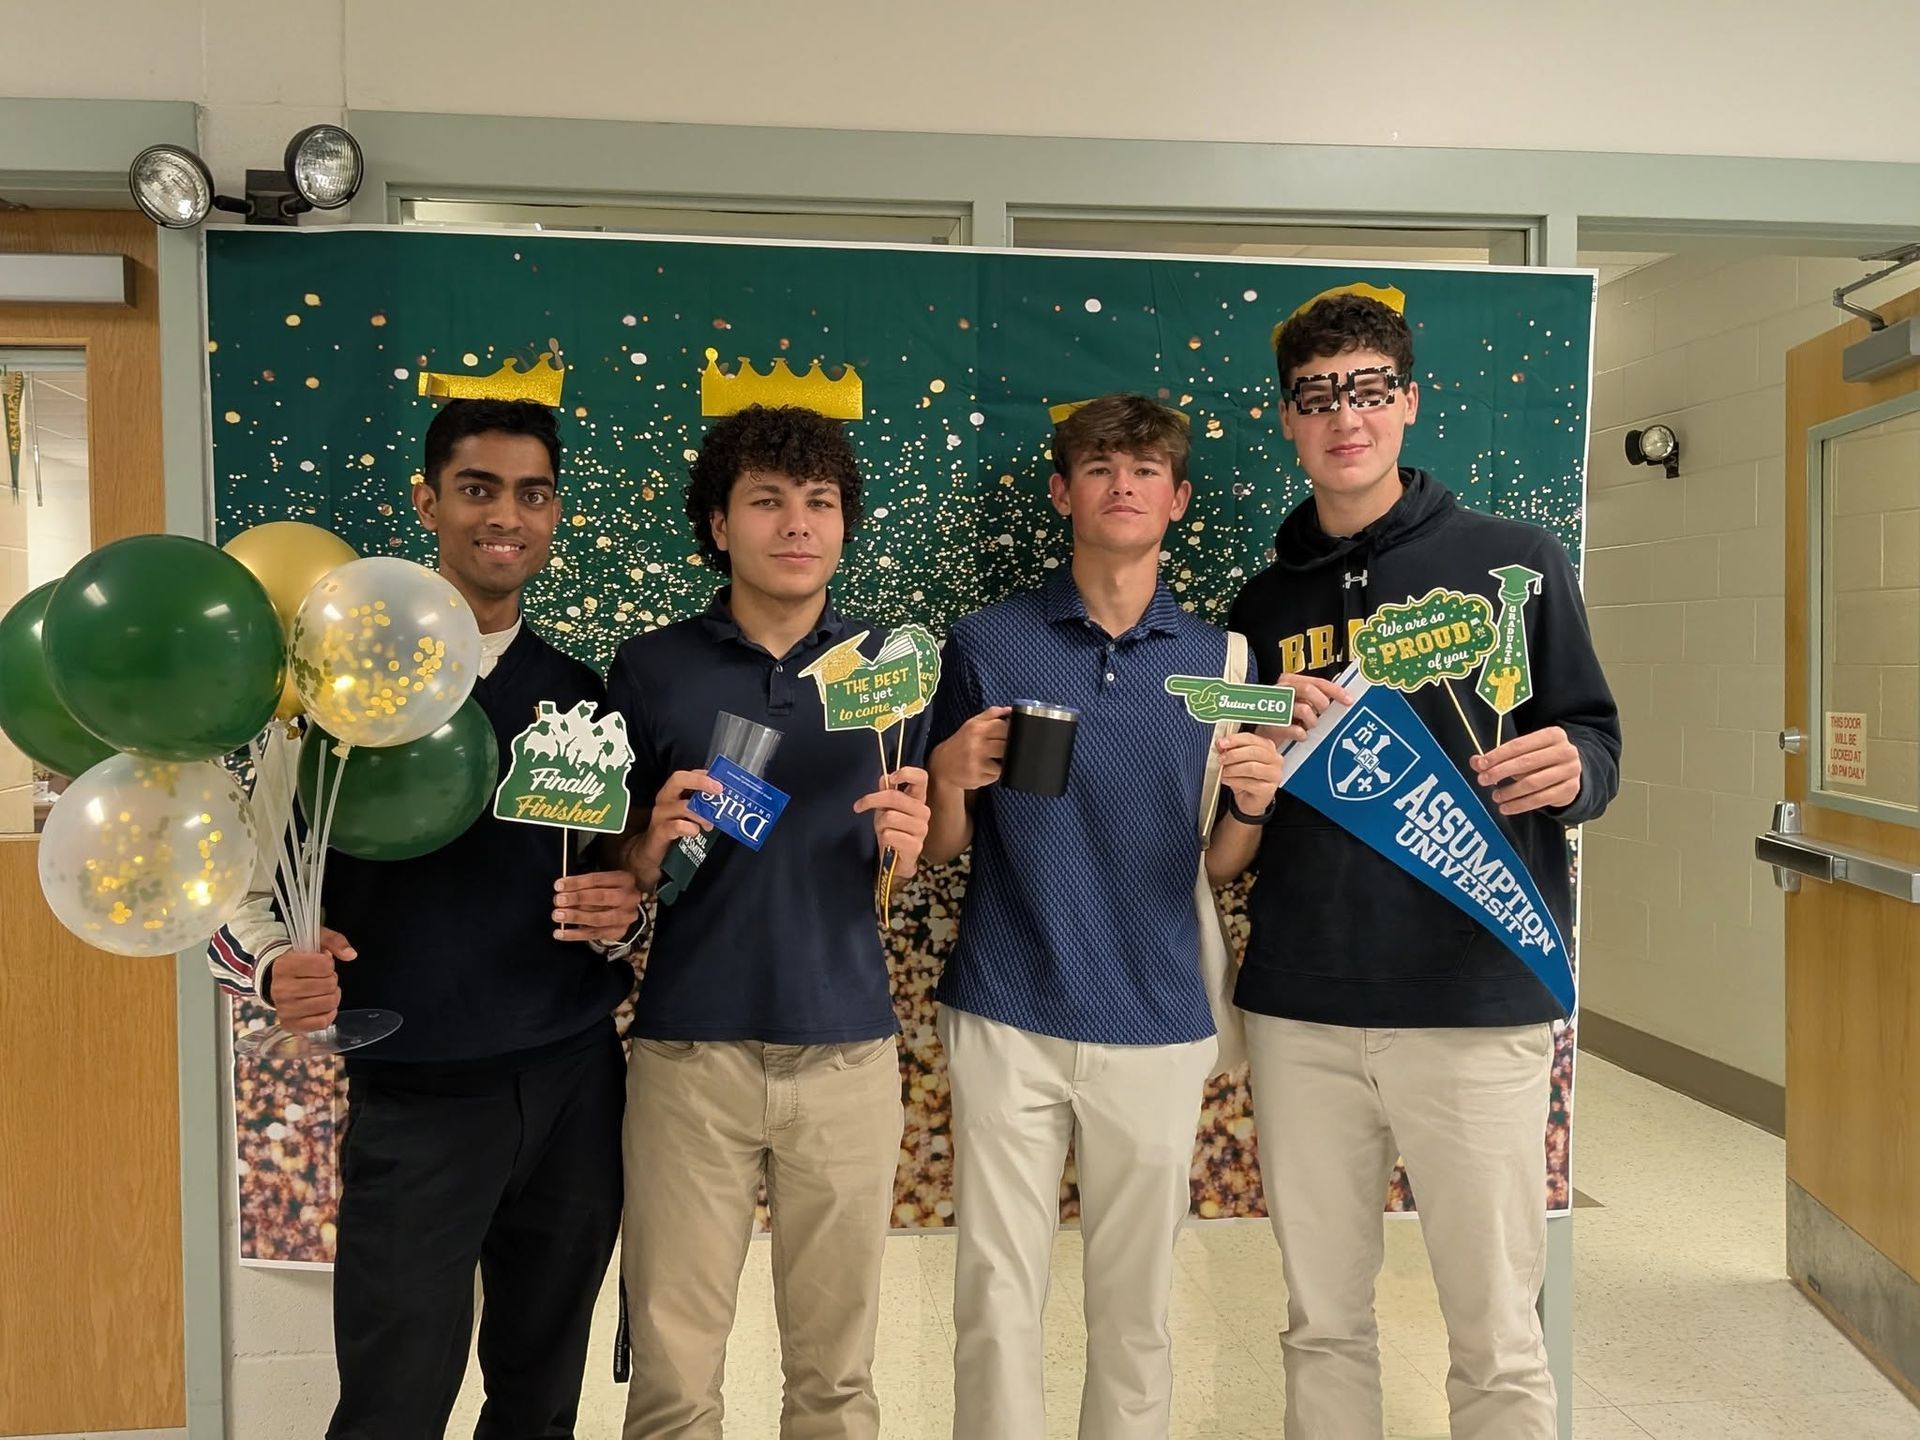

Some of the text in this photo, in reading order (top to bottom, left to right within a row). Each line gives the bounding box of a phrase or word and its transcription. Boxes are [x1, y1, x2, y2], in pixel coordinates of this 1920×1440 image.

[1377, 612, 1445, 637] We are so
[1503, 605, 1516, 665] GRADUATE
[1379, 621, 1471, 665] PROUD
[1427, 650, 1469, 670] of you
[843, 677, 870, 695] THE
[874, 667, 909, 688] BEST
[860, 687, 893, 704] is yet
[1219, 695, 1286, 713] Future CEO
[840, 703, 891, 721] to come
[1844, 717, 1861, 729] DOOR
[1834, 733, 1857, 746] WILL BE
[1830, 748, 1862, 762] LOCKED AT
[1848, 766, 1865, 779] DAILY
[530, 768, 605, 804] Finally
[516, 795, 611, 824] Finished
[723, 788, 771, 819] UNIVERS
[701, 791, 769, 842] Duke
[694, 832, 707, 849] AUL
[1393, 773, 1556, 956] ASSUMPTION
[1395, 820, 1536, 948] UNIVERSITY
